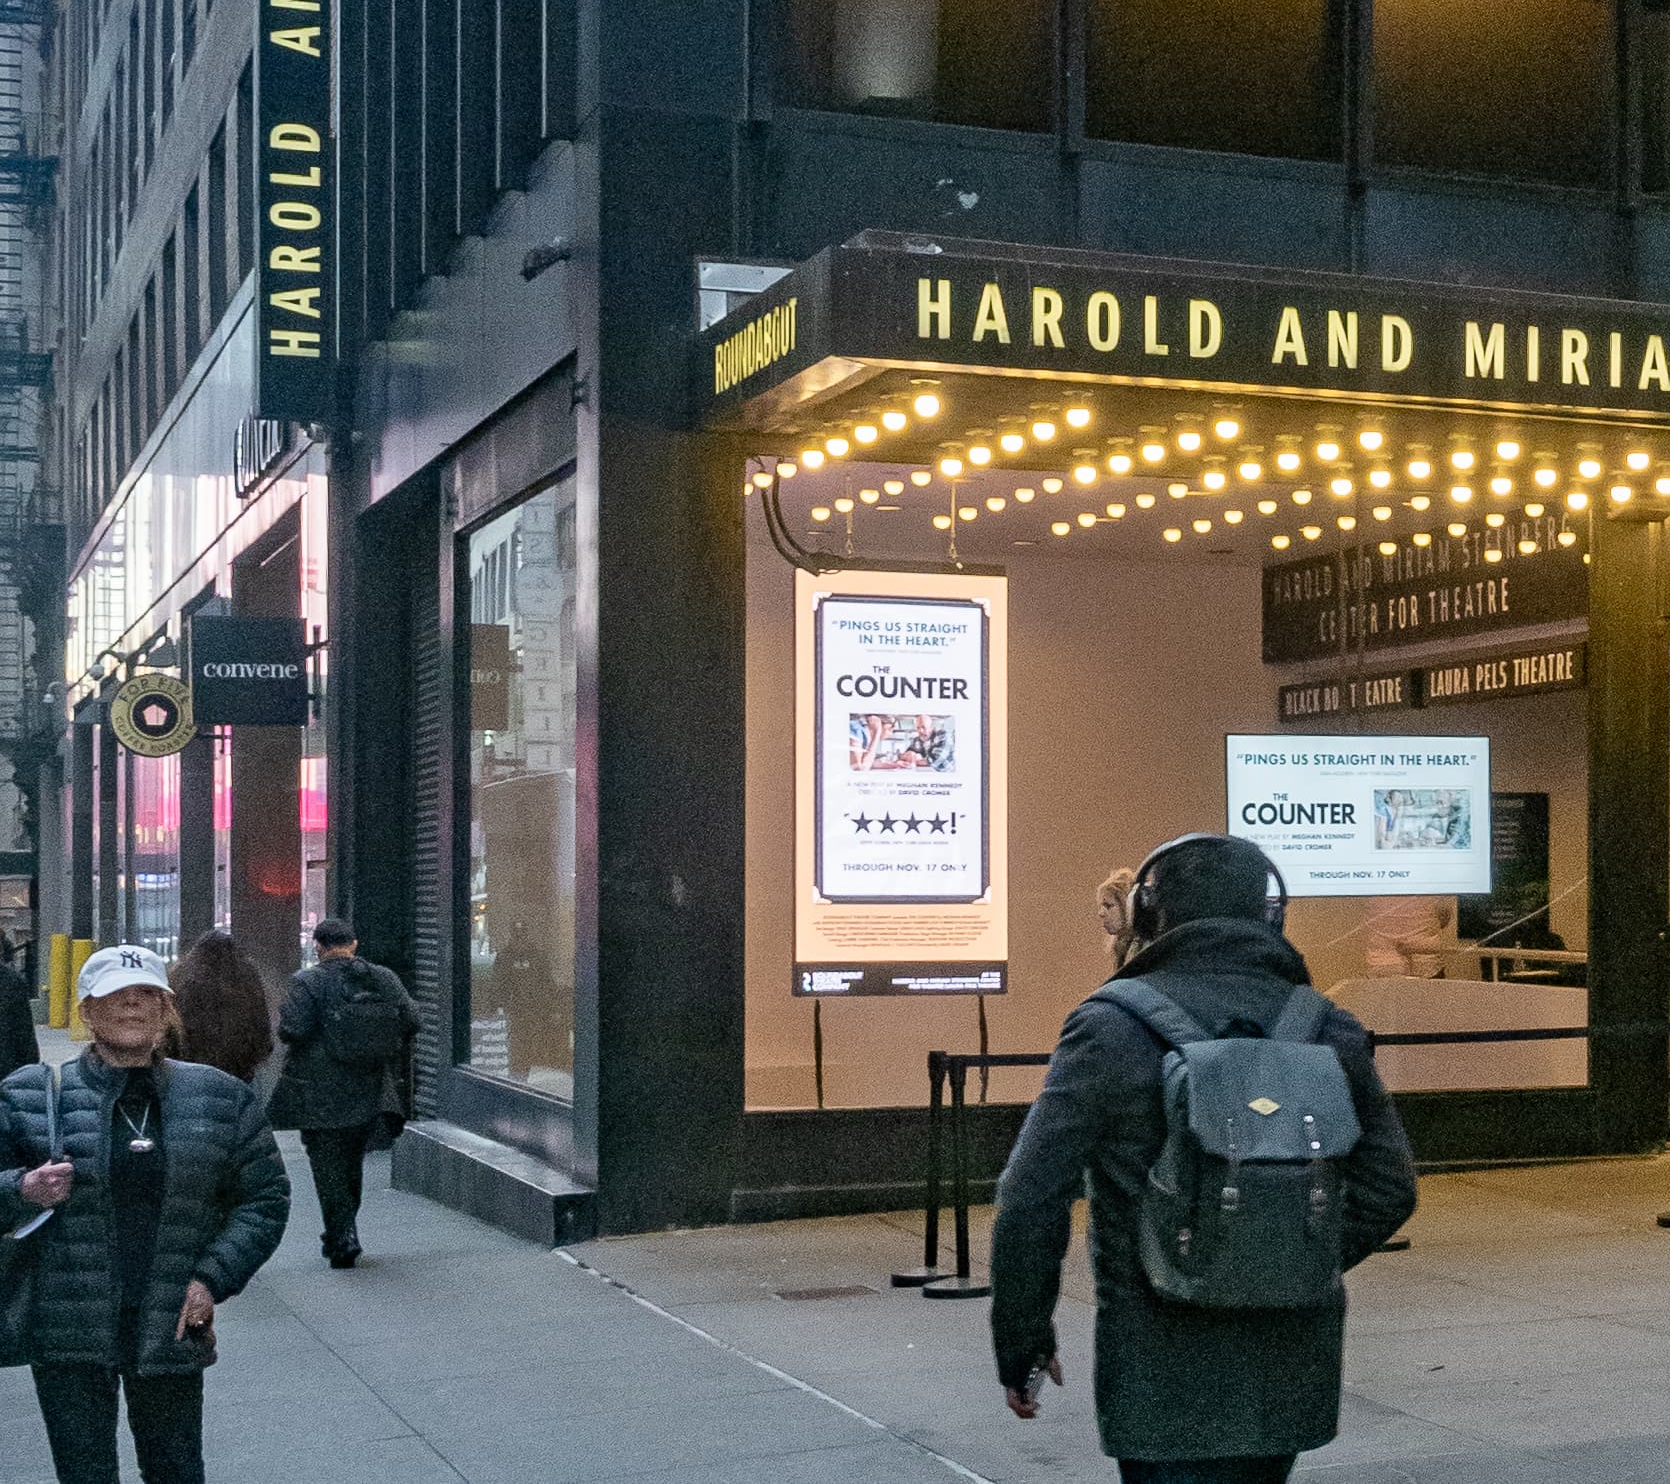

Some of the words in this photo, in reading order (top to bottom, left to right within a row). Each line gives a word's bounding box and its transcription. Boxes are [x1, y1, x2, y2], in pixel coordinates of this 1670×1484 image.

[269, 122, 321, 359] HAROLD
[917, 278, 1224, 359] HAROLD
[1272, 306, 1414, 372] AND
[715, 297, 798, 395] ROUNDABOUT
[1321, 603, 1378, 642] CETR
[1389, 595, 1418, 631] FOR
[1429, 578, 1509, 624] THEATRE
[885, 622, 901, 632] US
[907, 623, 968, 634] STRAIGHT
[859, 634, 873, 644] IN
[879, 635, 900, 645] THE
[203, 661, 299, 679] convene
[873, 665, 890, 674] THE
[1430, 667, 1469, 697] LAURA
[1476, 660, 1507, 691] PELS
[1513, 651, 1573, 685] THEATRE
[837, 674, 969, 700] COUNTER
[1324, 686, 1342, 711] BO
[1350, 677, 1402, 709] TEATRE
[1292, 754, 1308, 765] US
[1314, 755, 1377, 766] STRAIGHT
[1380, 755, 1395, 766] IN
[1400, 755, 1422, 766] THE
[1273, 793, 1288, 801] THE
[1241, 803, 1357, 825] COUNTER
[843, 863, 893, 872] THROUGH
[927, 864, 937, 872] 17
[941, 864, 967, 872] ONY
[1309, 871, 1350, 879] THROUGH
[1353, 871, 1374, 879] NOV.
[1377, 871, 1386, 879] 17
[1389, 870, 1410, 879] ONLY
